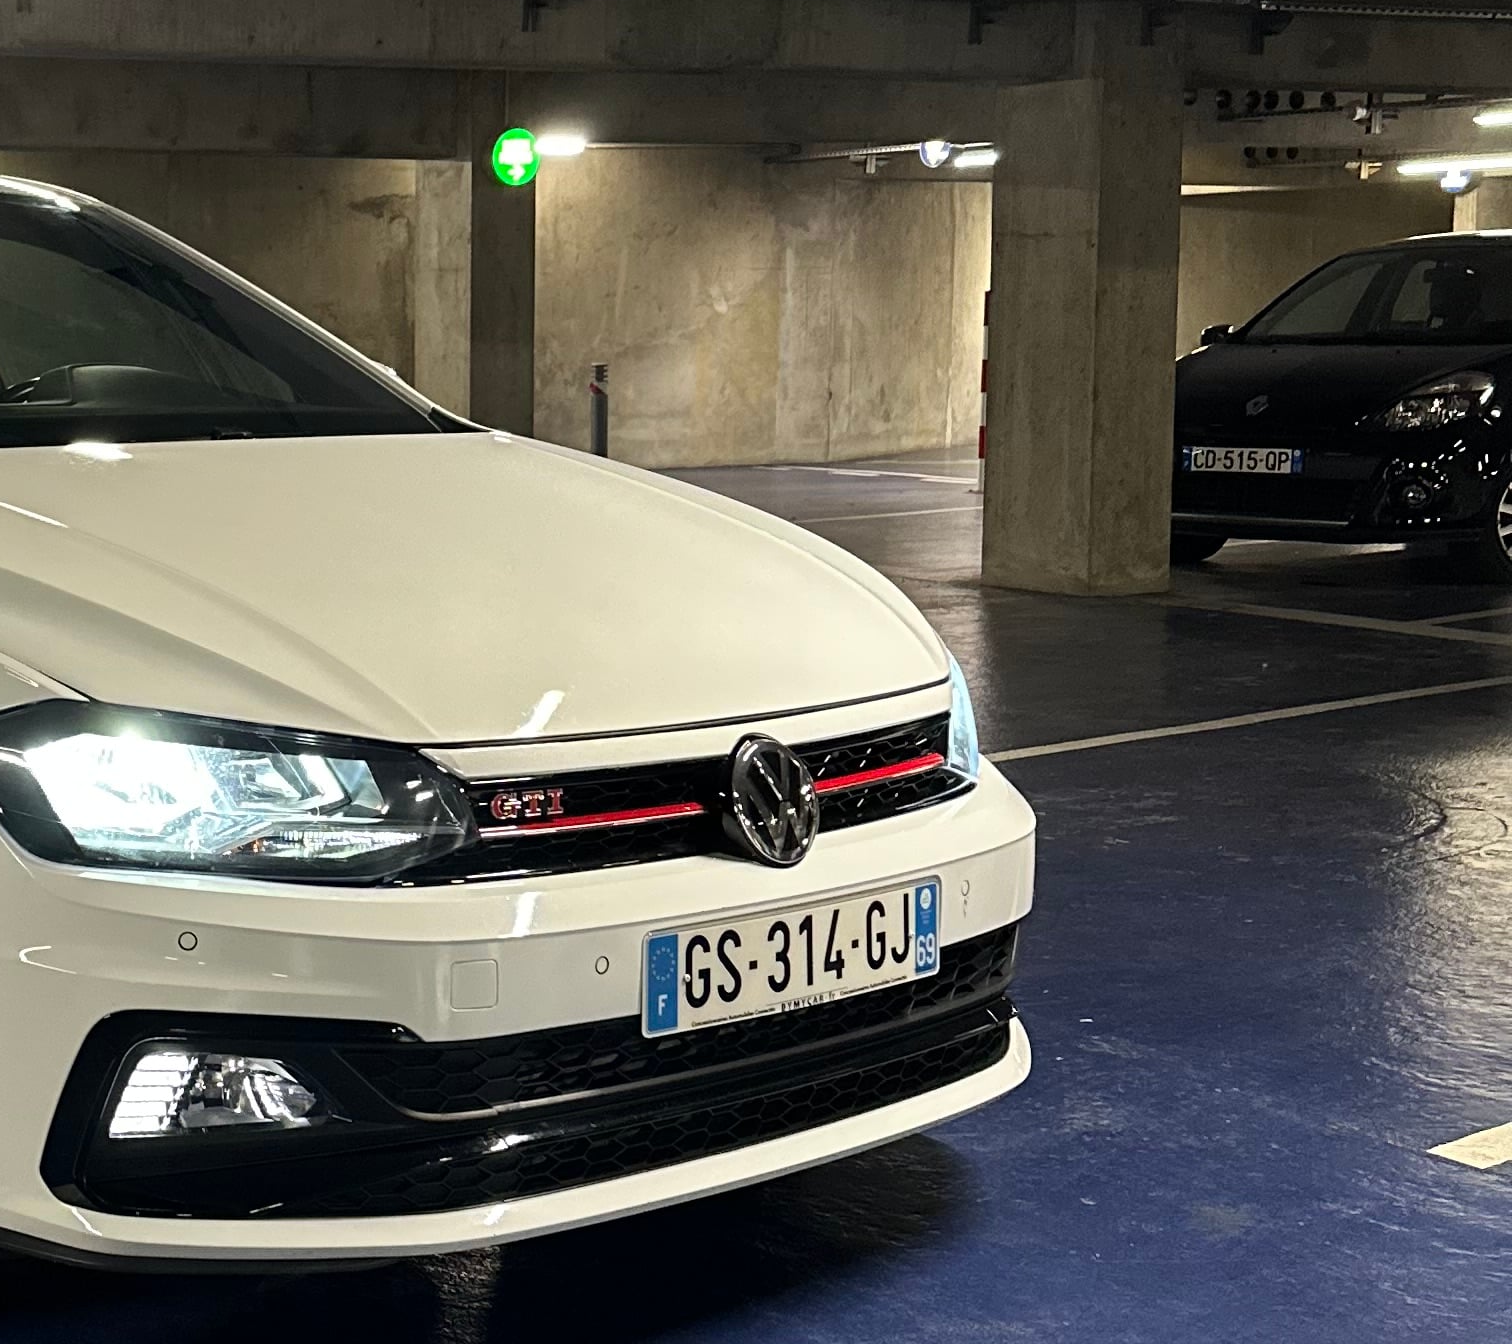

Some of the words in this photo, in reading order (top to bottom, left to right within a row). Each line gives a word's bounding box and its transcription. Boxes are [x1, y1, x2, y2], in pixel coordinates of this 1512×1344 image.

[1192, 448, 1290, 472] CD-515-QP
[490, 787, 564, 820] GTI
[685, 892, 910, 1009] GS-314-GJ
[916, 932, 936, 967] 69
[658, 994, 668, 1017] F
